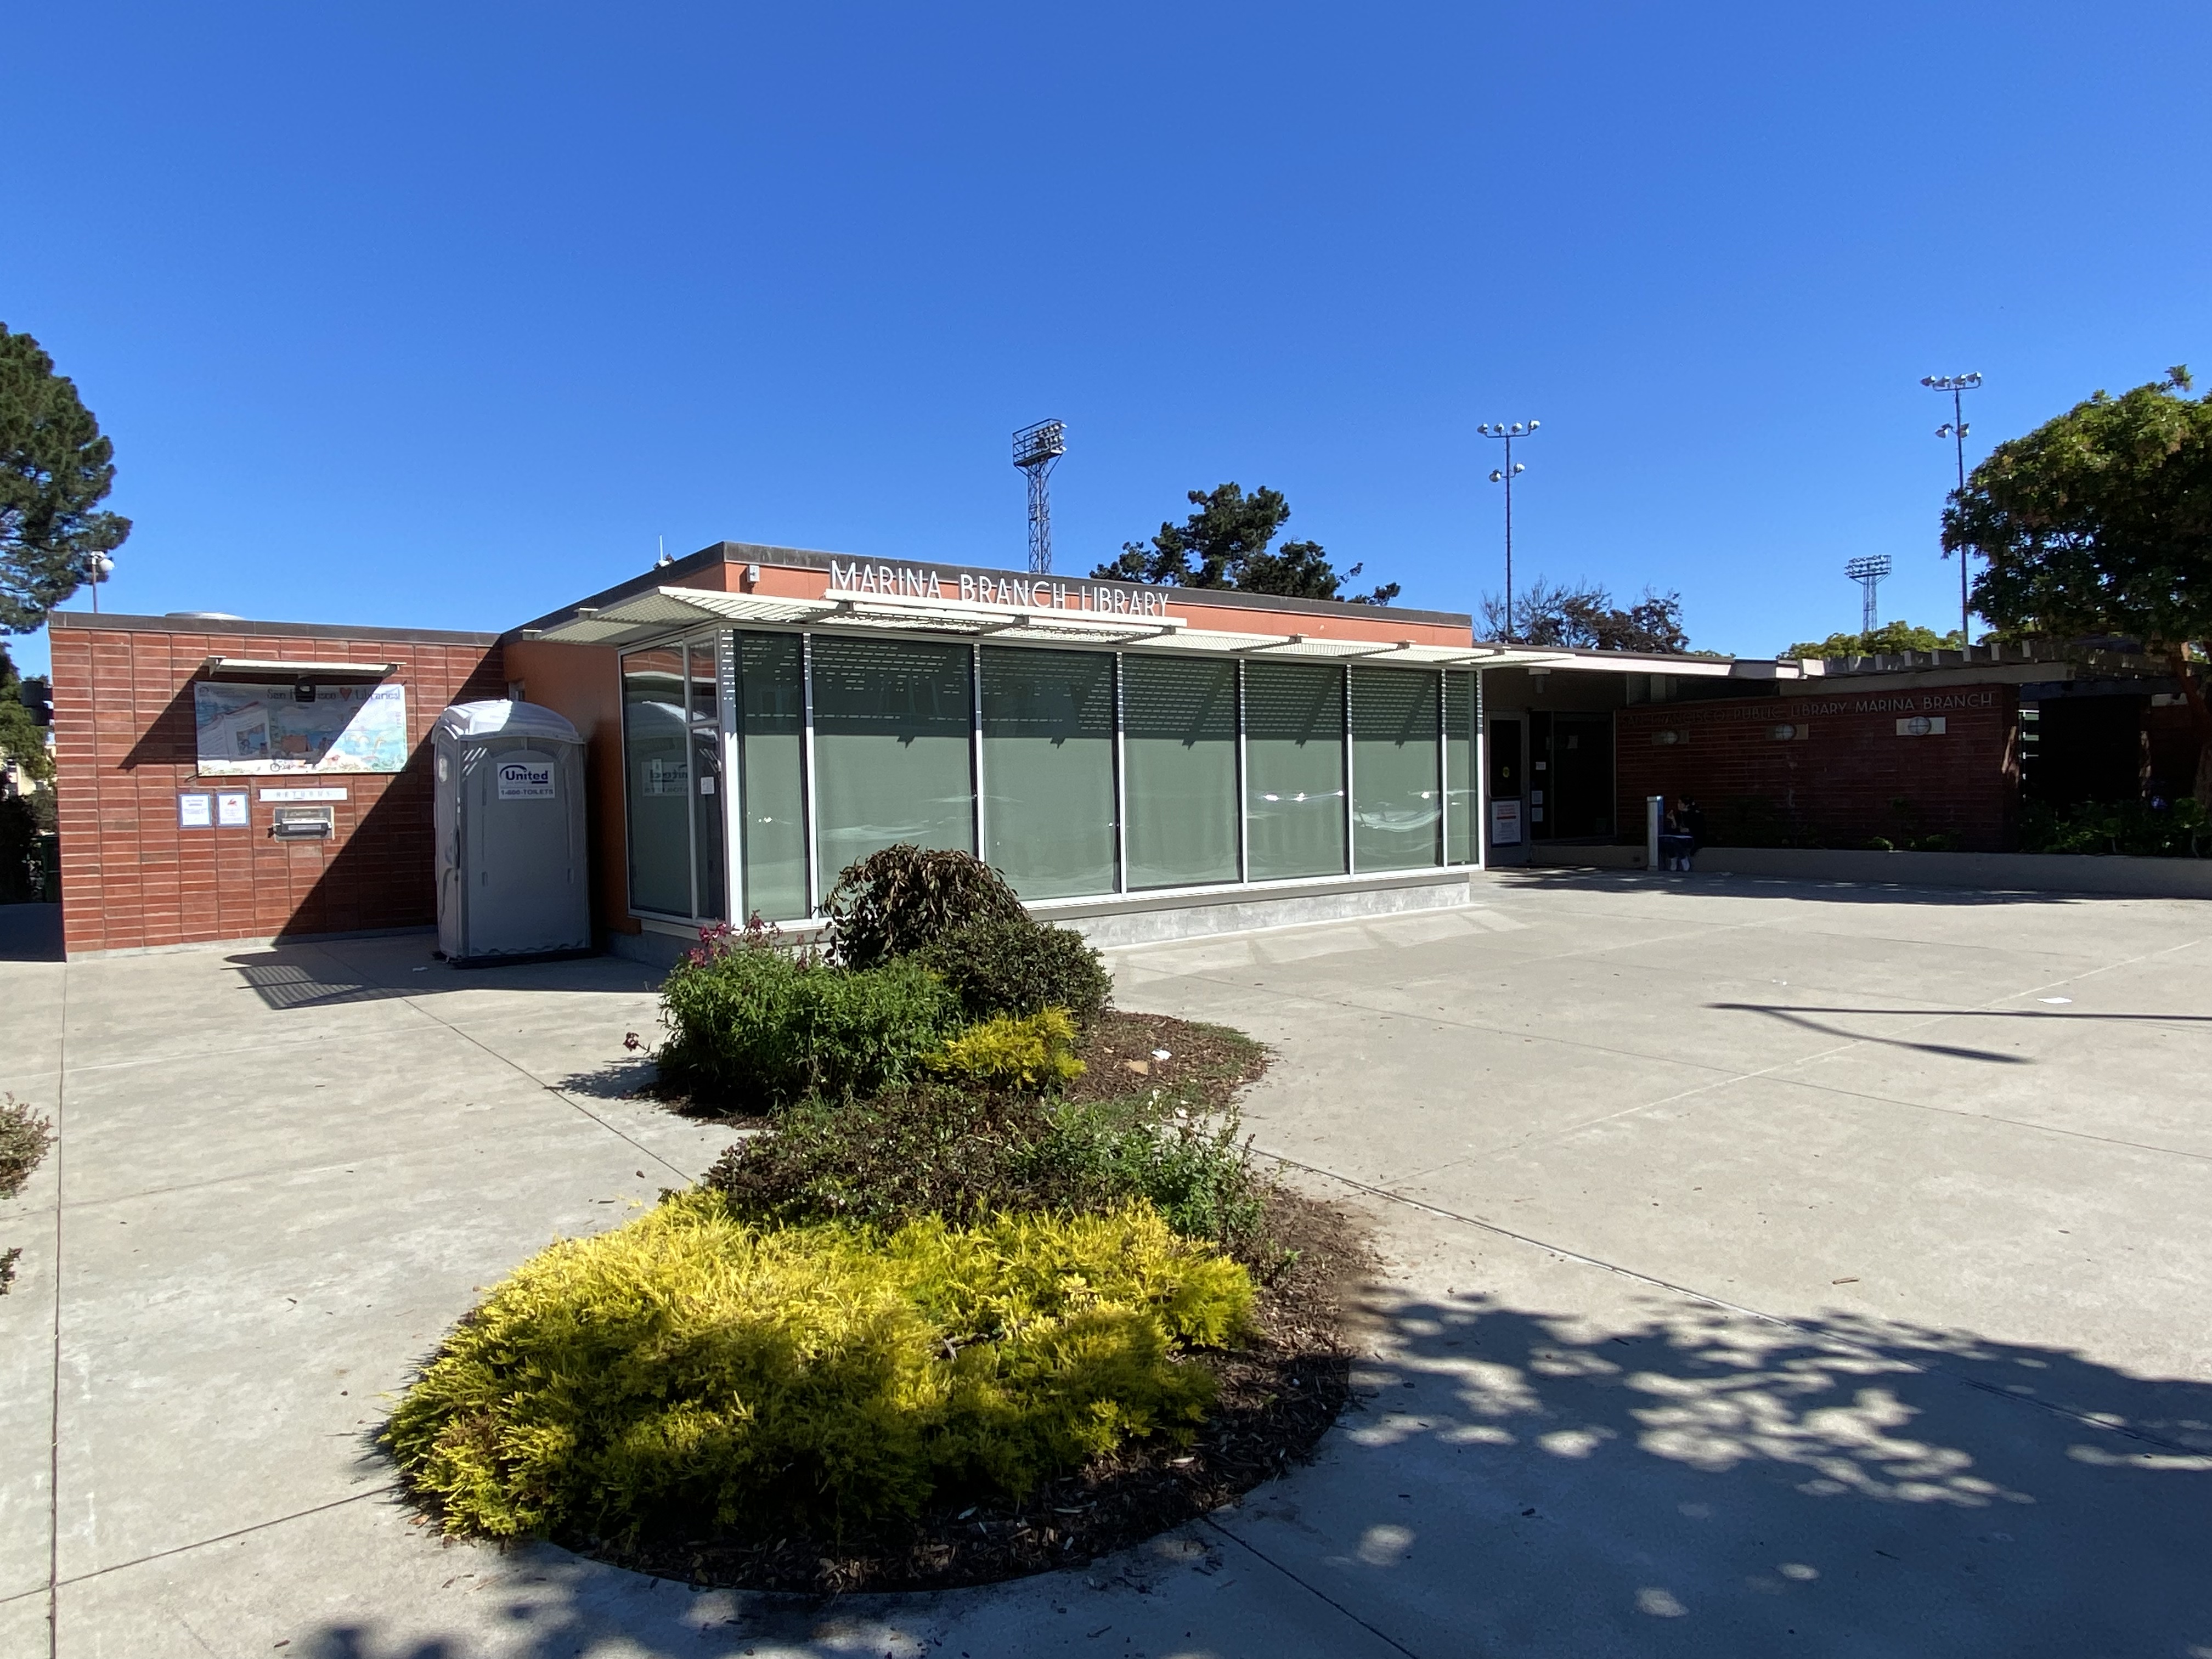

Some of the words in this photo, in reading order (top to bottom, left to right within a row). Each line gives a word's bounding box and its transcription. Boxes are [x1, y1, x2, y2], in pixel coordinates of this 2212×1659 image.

[830, 560, 942, 599] MARINA
[960, 574, 1066, 610] BRANCH
[1080, 586, 1170, 617] LIBRARY
[267, 689, 286, 699] San
[1734, 707, 1781, 720] PUBLIC
[1791, 702, 1847, 717] LIBRARY
[1855, 698, 1915, 713] MARINA
[1922, 693, 1993, 710] BRANCH
[505, 770, 549, 781] United
